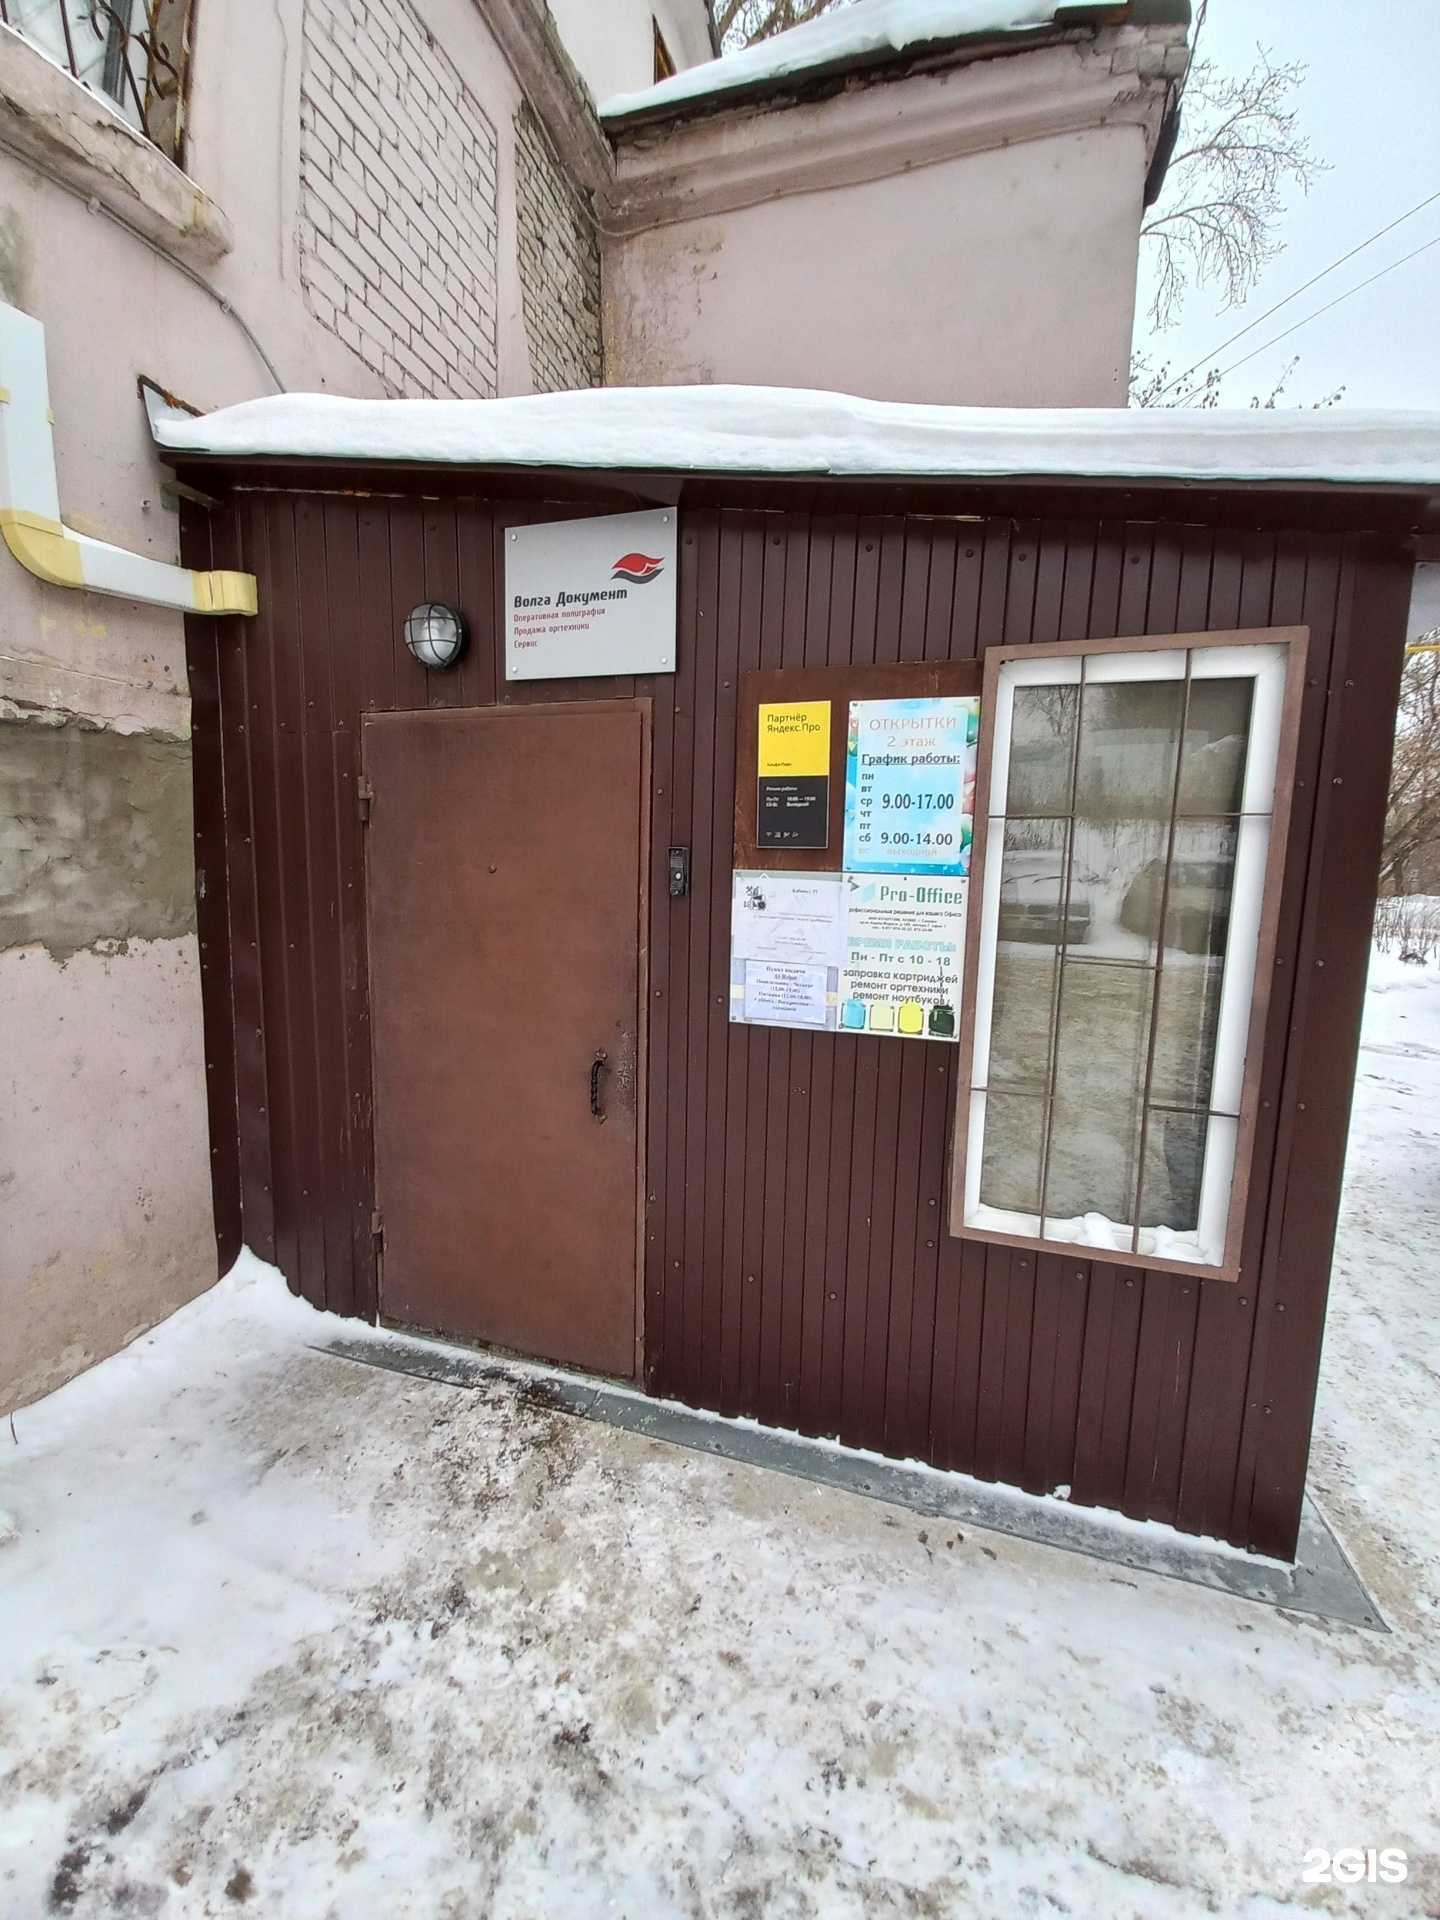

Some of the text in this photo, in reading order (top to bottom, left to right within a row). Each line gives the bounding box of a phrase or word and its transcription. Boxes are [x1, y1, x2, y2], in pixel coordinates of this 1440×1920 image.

[514, 589, 628, 608] Волга Документ
[514, 608, 606, 622] Оперативная полиграфия
[514, 623, 590, 636] Продажа оргтехники
[514, 640, 538, 649] Сервис
[767, 713, 807, 723] Партнёр
[869, 717, 957, 731] ОТКРЫТКИ
[887, 735, 936, 747] 2 этаж
[861, 752, 961, 766] График работы:
[860, 798, 873, 807] ср
[882, 793, 954, 810] 9.00-17.00
[860, 810, 872, 818] чт
[858, 833, 871, 843] сб
[880, 832, 953, 846] 9.00-14.00
[880, 885, 963, 904] Pro-Office
[851, 952, 868, 962] Пн
[879, 953, 894, 963] Пт
[897, 956, 905, 964] с
[910, 955, 924, 965] 10
[936, 956, 951, 967] 18
[843, 969, 958, 984] заправка картриджей
[850, 981, 949, 996] ремонт оргтехники
[852, 991, 946, 1006] ремонт ноутбуков
